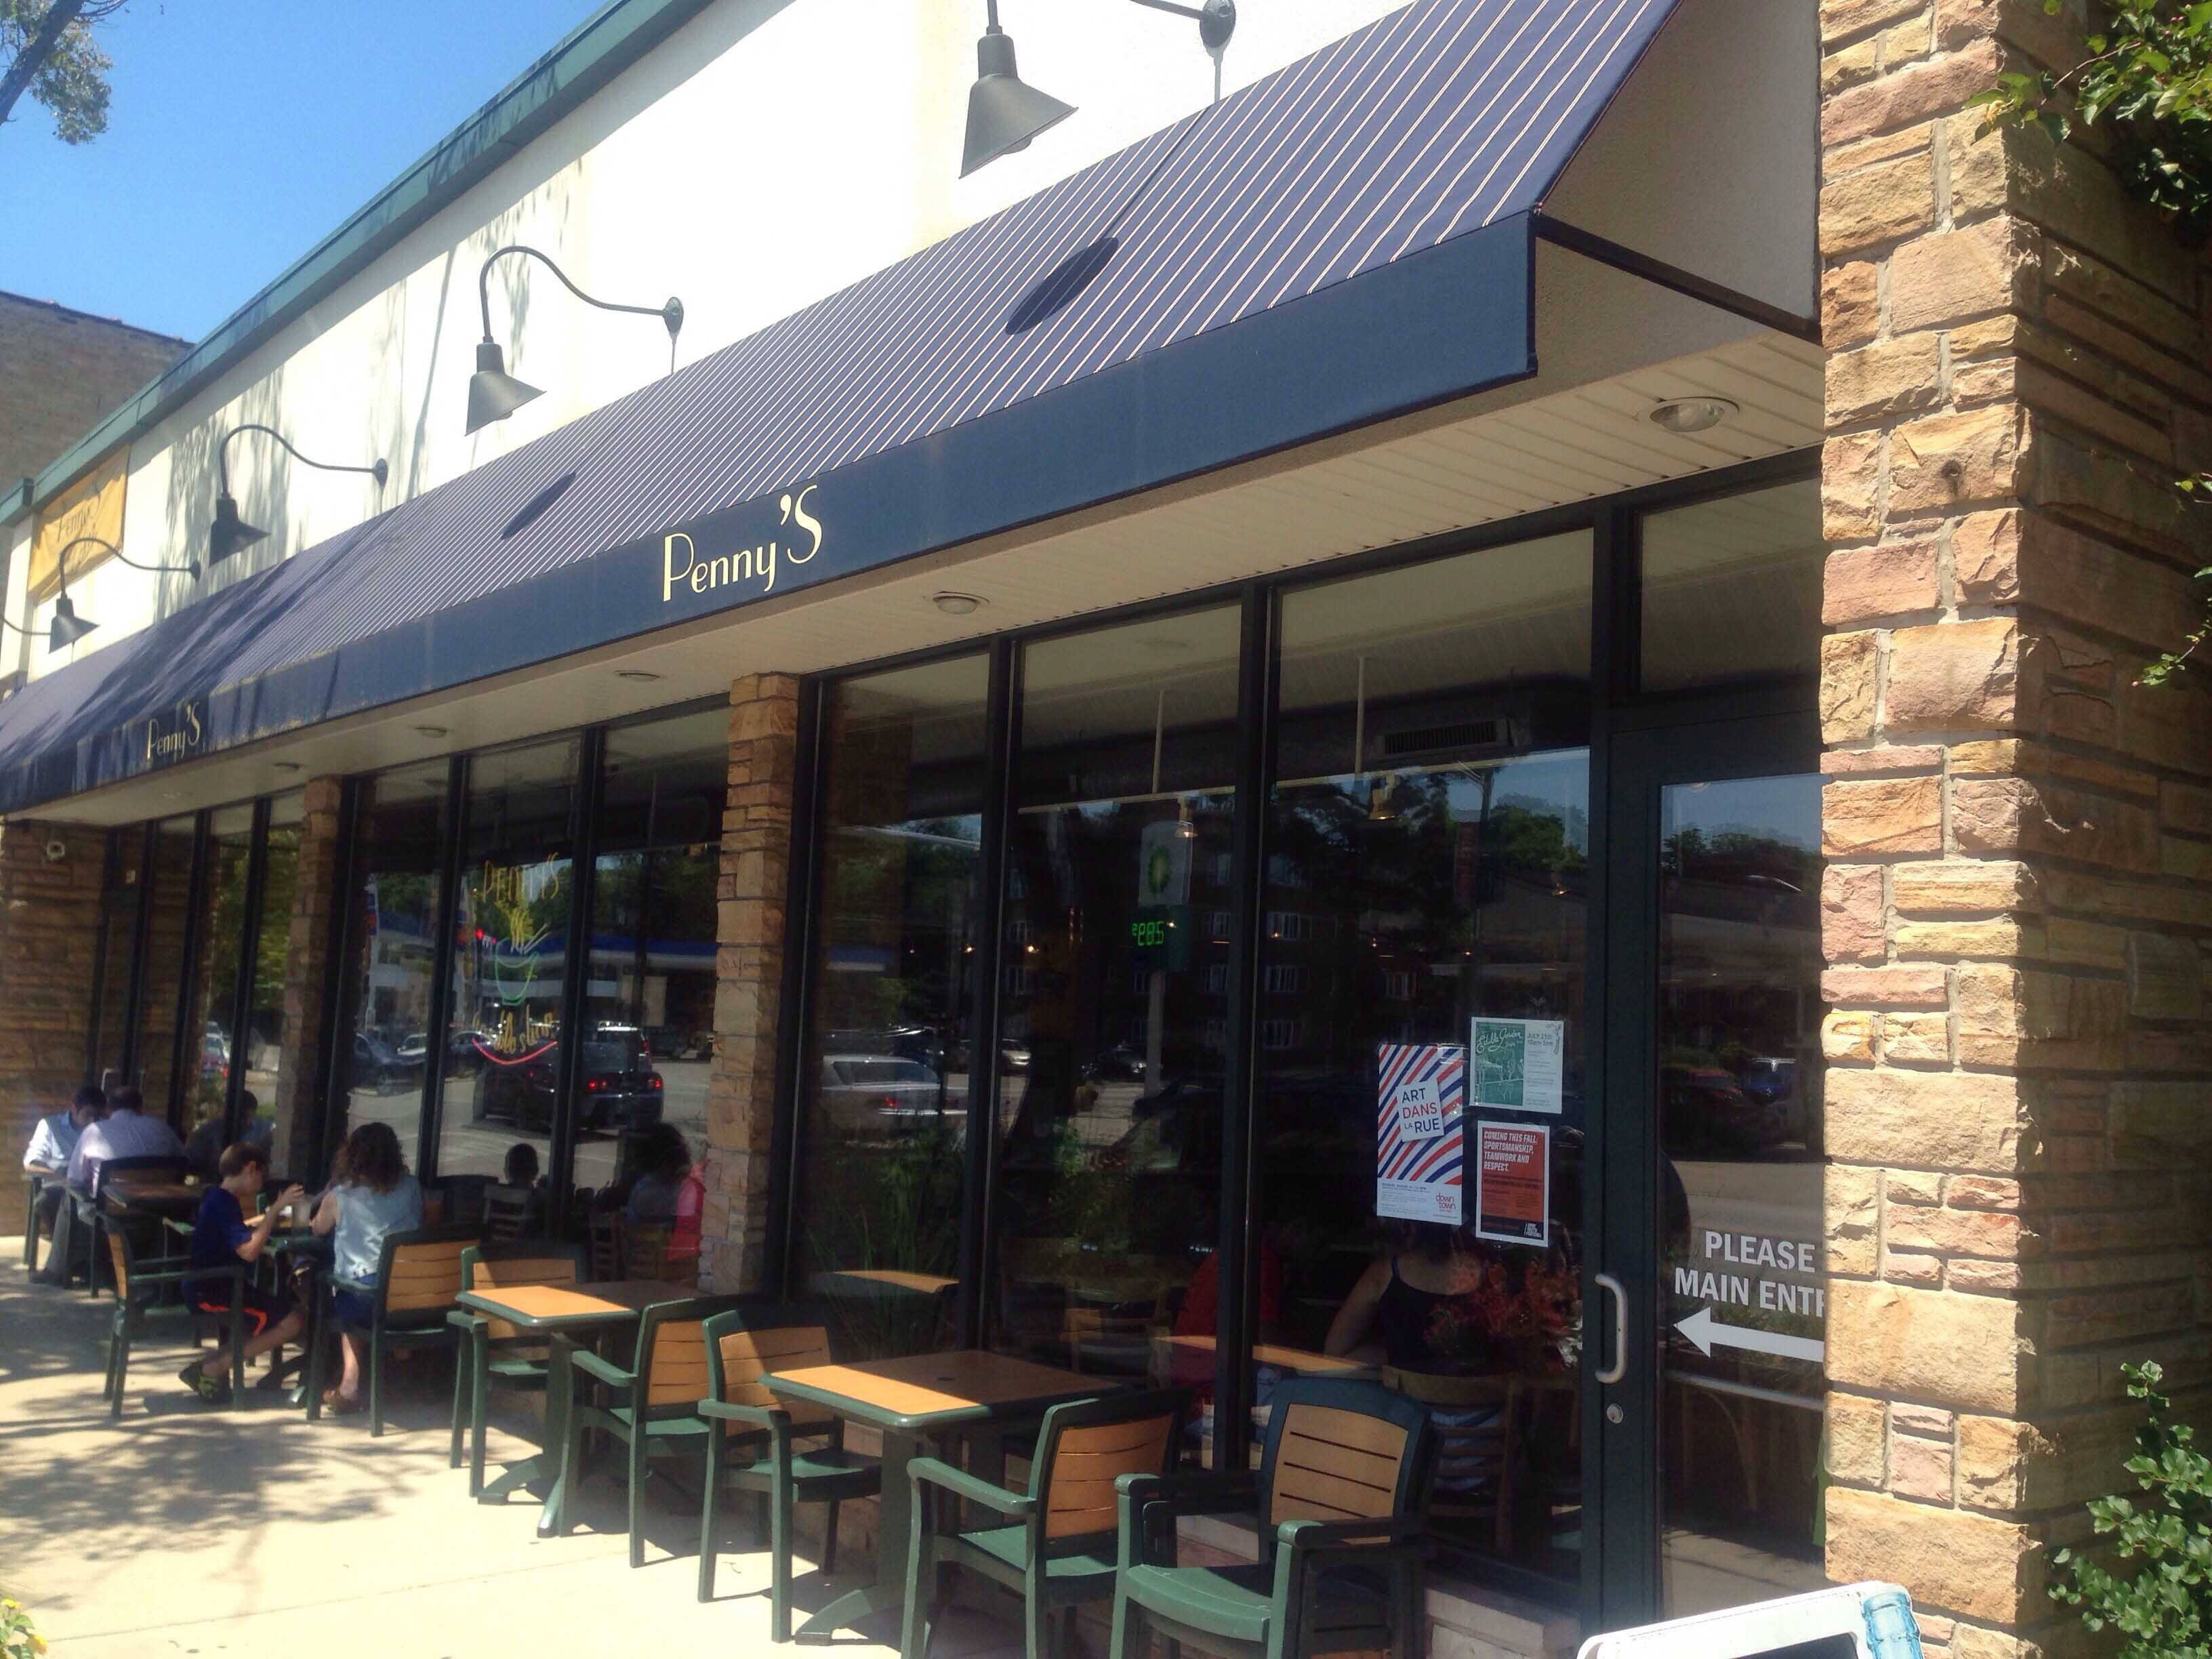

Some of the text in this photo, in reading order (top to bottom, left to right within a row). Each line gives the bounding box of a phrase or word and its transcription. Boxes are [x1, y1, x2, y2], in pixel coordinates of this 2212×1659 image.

[1402, 1088, 1426, 1104] ART
[1403, 1102, 1437, 1119] DANS
[1414, 1118, 1440, 1133] RUE
[1484, 1131, 1508, 1141] COMING
[1509, 1133, 1523, 1142] THIS
[1484, 1151, 1530, 1163] TEAMWORK AND
[1483, 1162, 1509, 1171] RESPECT.
[1436, 1193, 1454, 1202] down
[1704, 1231, 1816, 1273] PLEASE
[1675, 1267, 1749, 1306] MAIN
